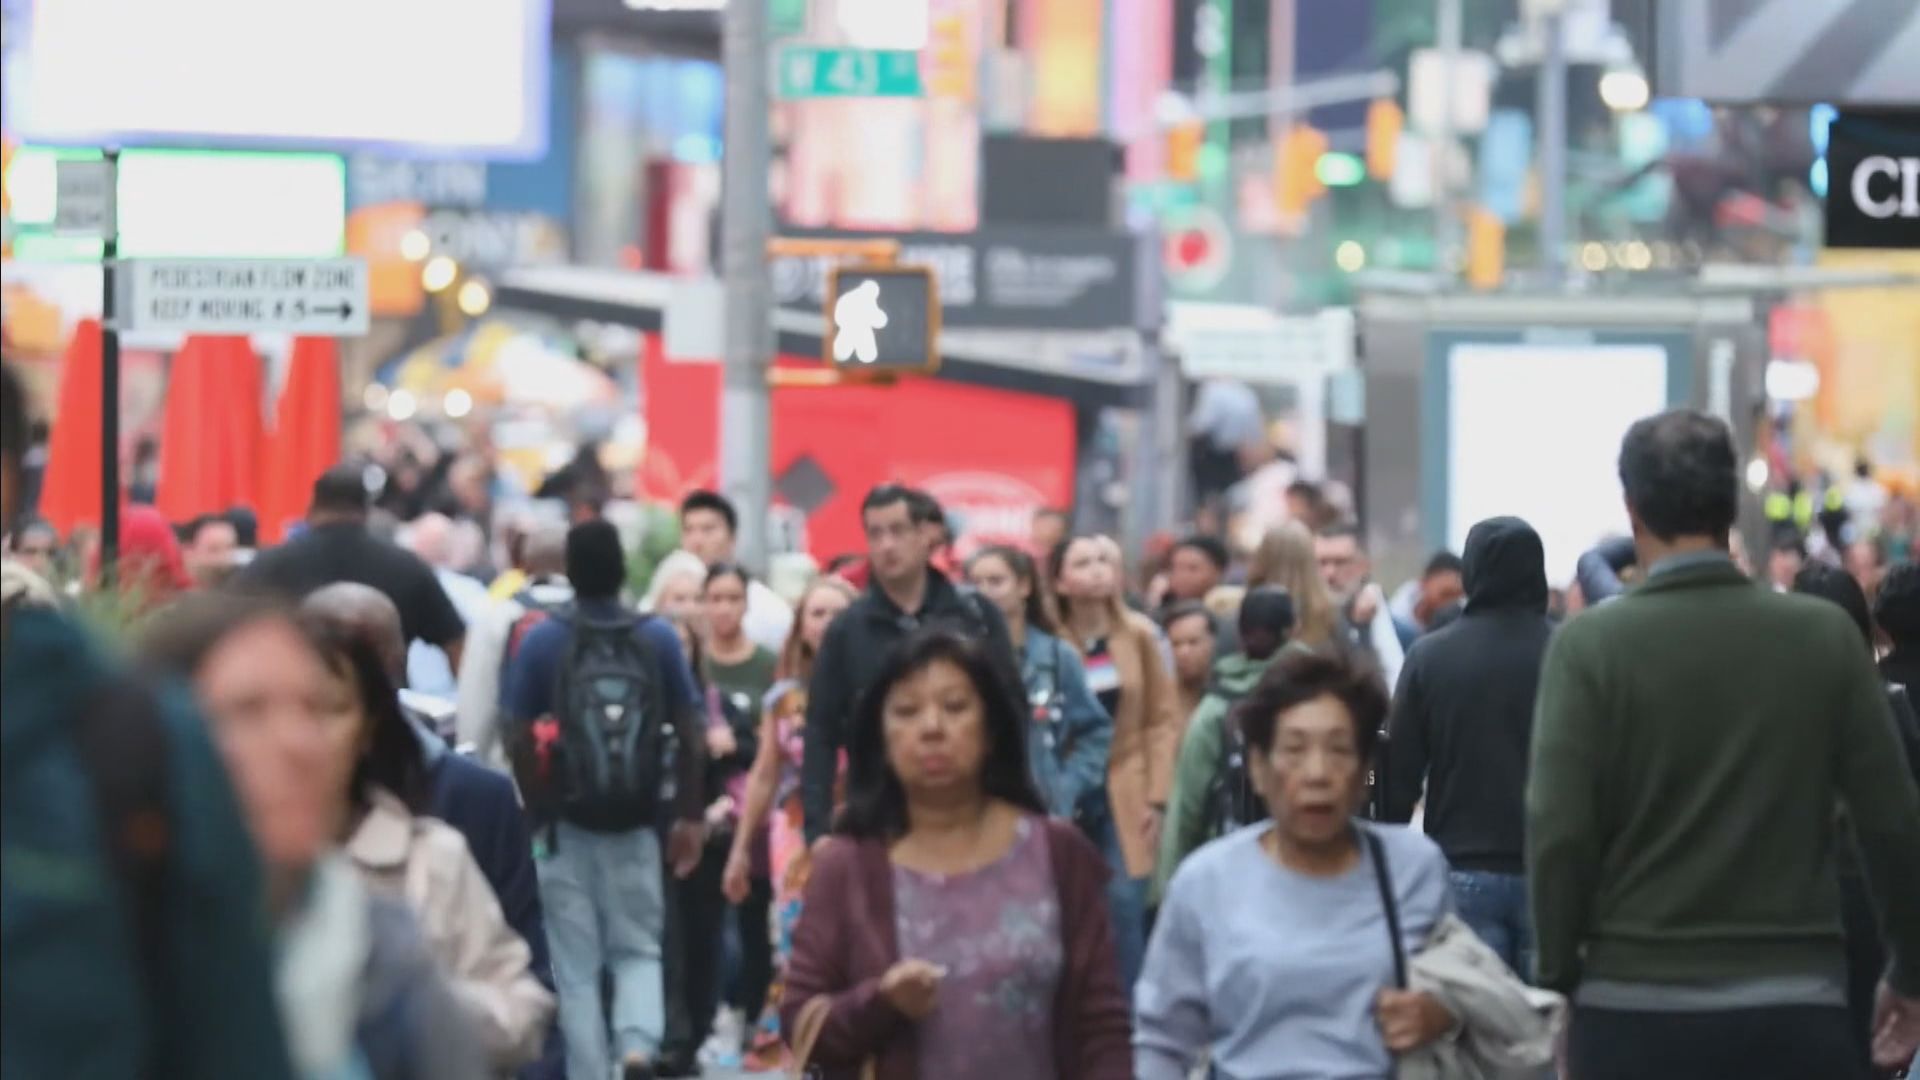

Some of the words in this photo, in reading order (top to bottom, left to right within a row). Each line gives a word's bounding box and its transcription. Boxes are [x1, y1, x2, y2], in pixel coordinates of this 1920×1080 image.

[826, 52, 878, 94] 43
[151, 268, 255, 289] PEDESTRIAN
[262, 268, 306, 289] FLOW
[313, 267, 355, 289] ZONE
[151, 298, 191, 321] KEEP
[199, 298, 263, 321] MOVING
